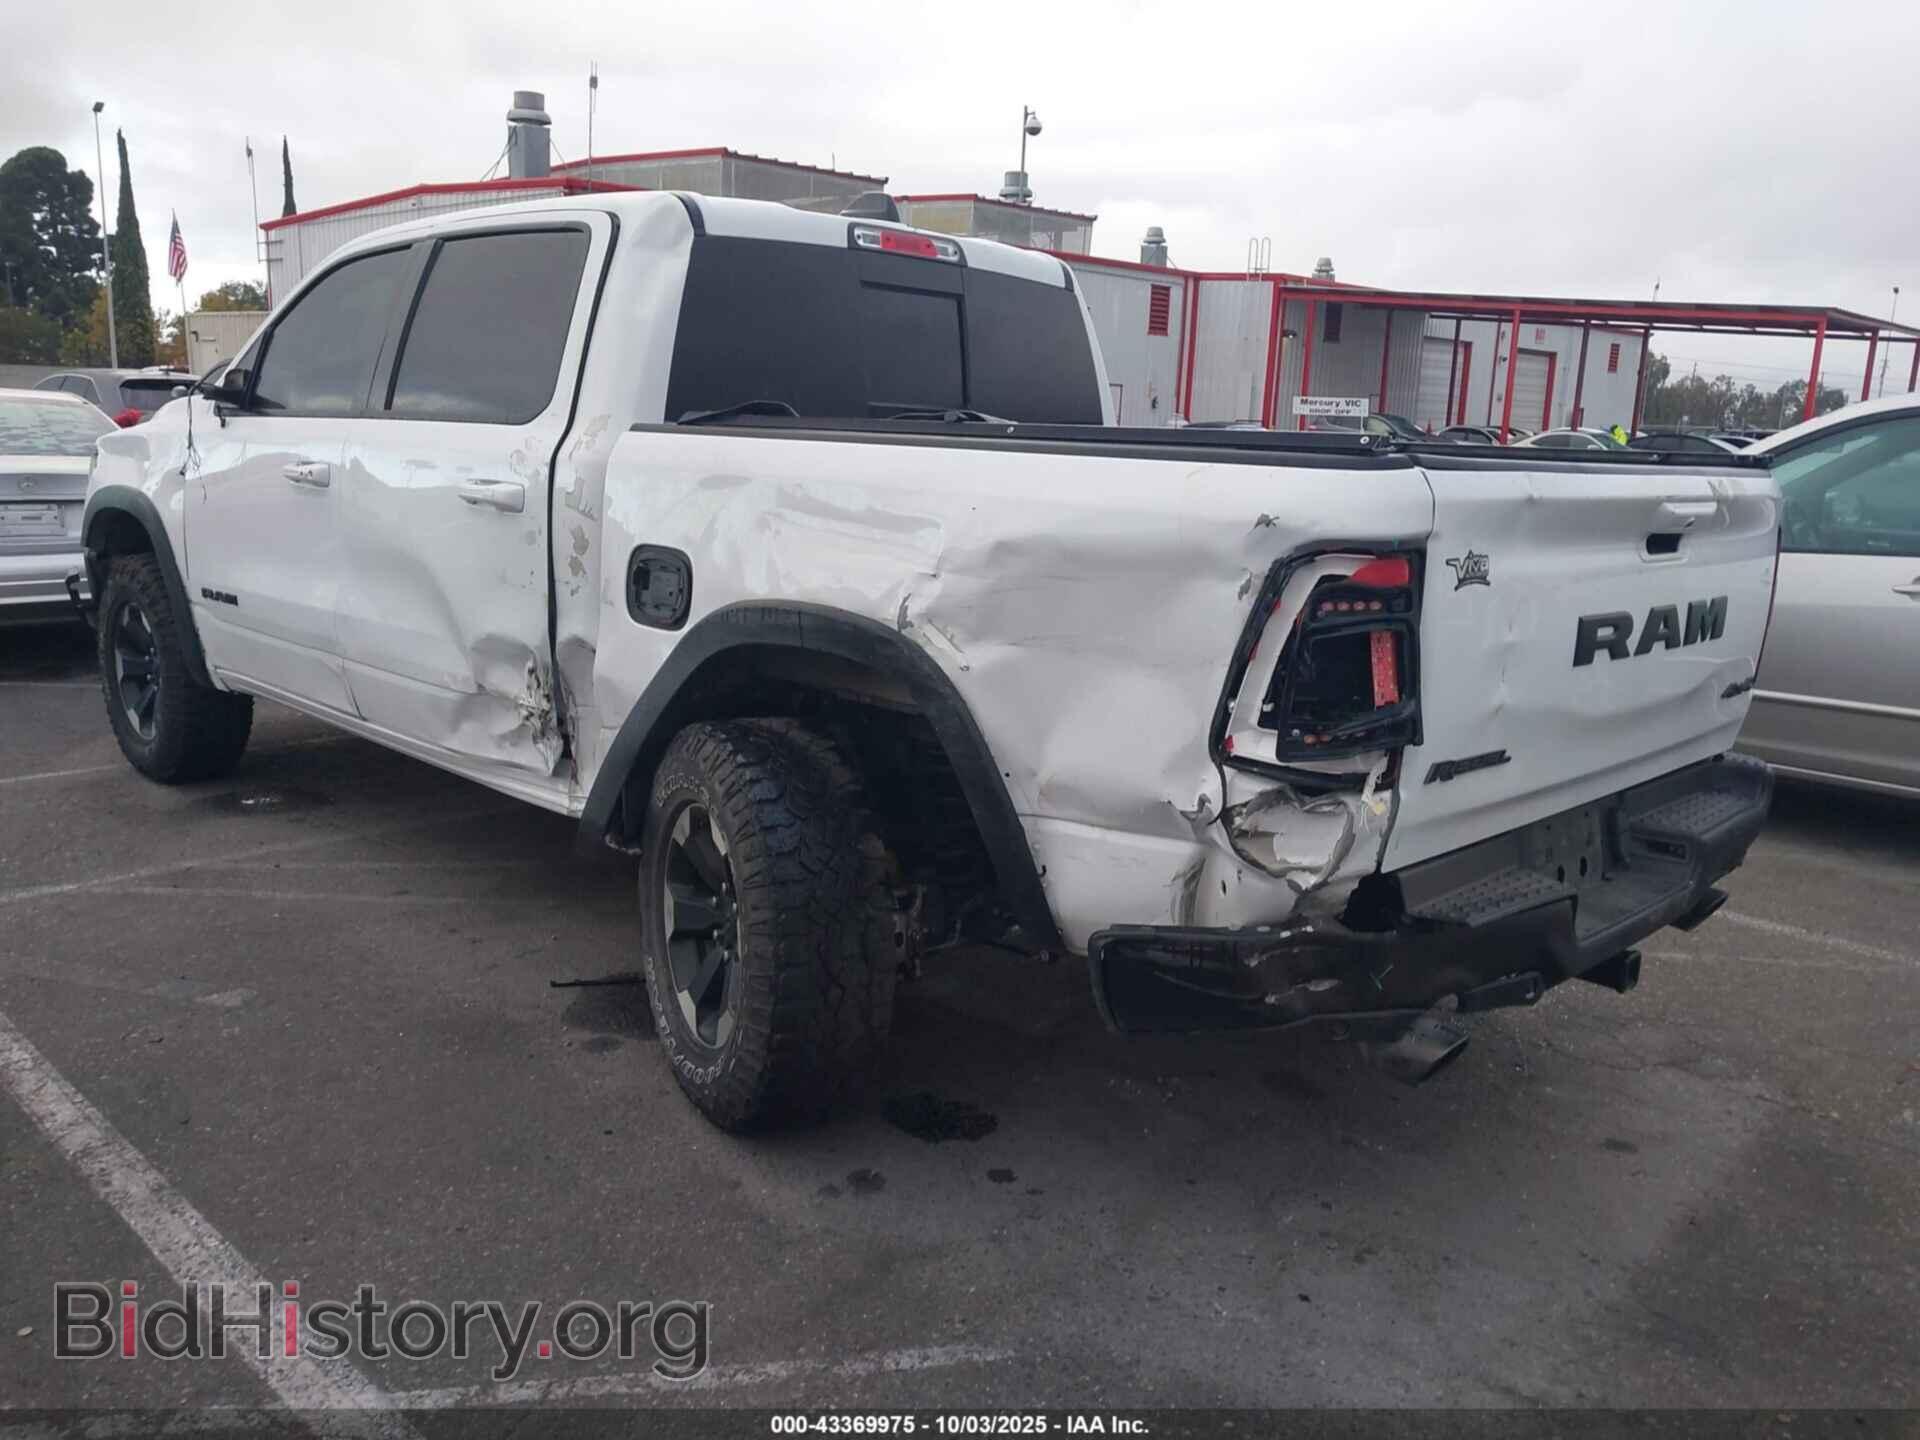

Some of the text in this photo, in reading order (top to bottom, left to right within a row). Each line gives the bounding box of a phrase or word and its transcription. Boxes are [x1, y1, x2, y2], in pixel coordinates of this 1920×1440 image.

[1300, 398, 1361, 408] Mercury VIC
[1573, 595, 1728, 667] RAM
